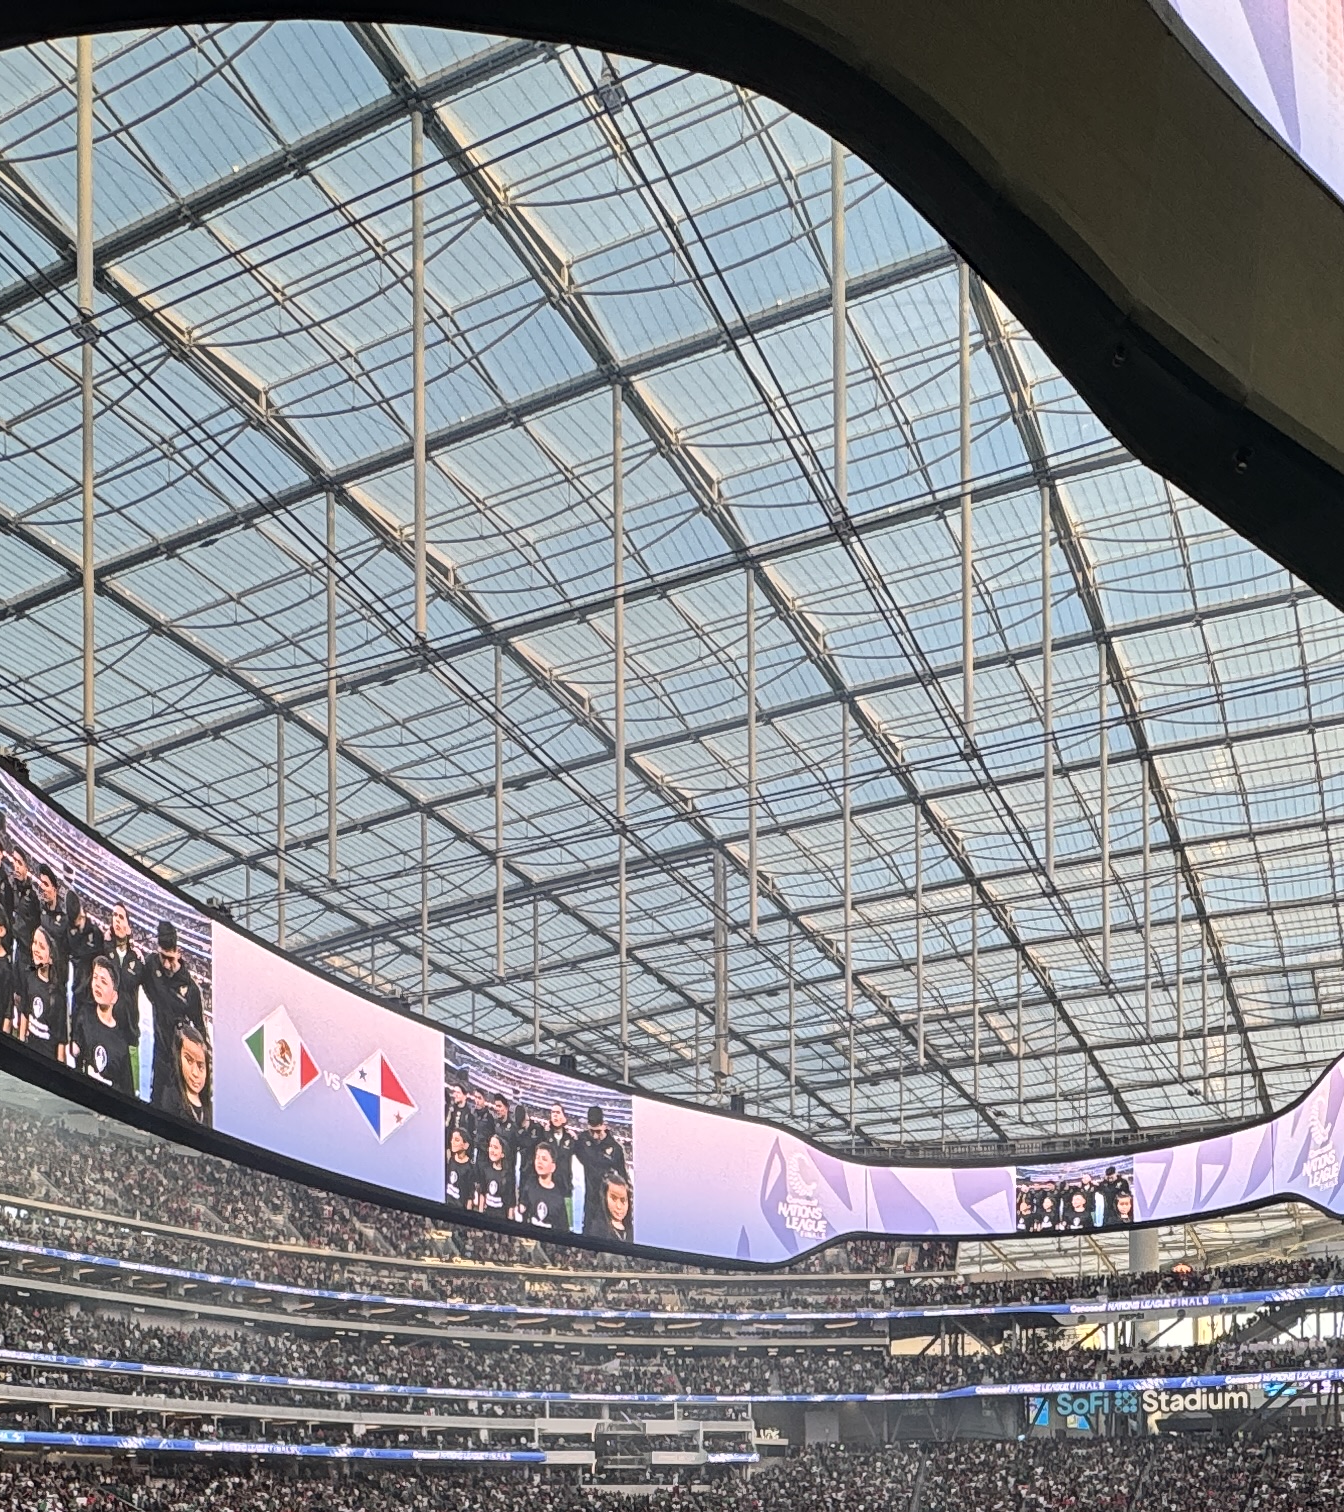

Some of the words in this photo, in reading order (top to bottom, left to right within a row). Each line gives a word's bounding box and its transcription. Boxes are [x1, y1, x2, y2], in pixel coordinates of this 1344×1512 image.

[777, 1201, 823, 1219] NATIONS
[785, 1217, 827, 1233] LEAGUE
[1170, 1296, 1210, 1307] FINALS
[1069, 1381, 1105, 1391] FINALS
[1057, 1391, 1109, 1416] SoFi
[1142, 1388, 1248, 1413] Stadium
